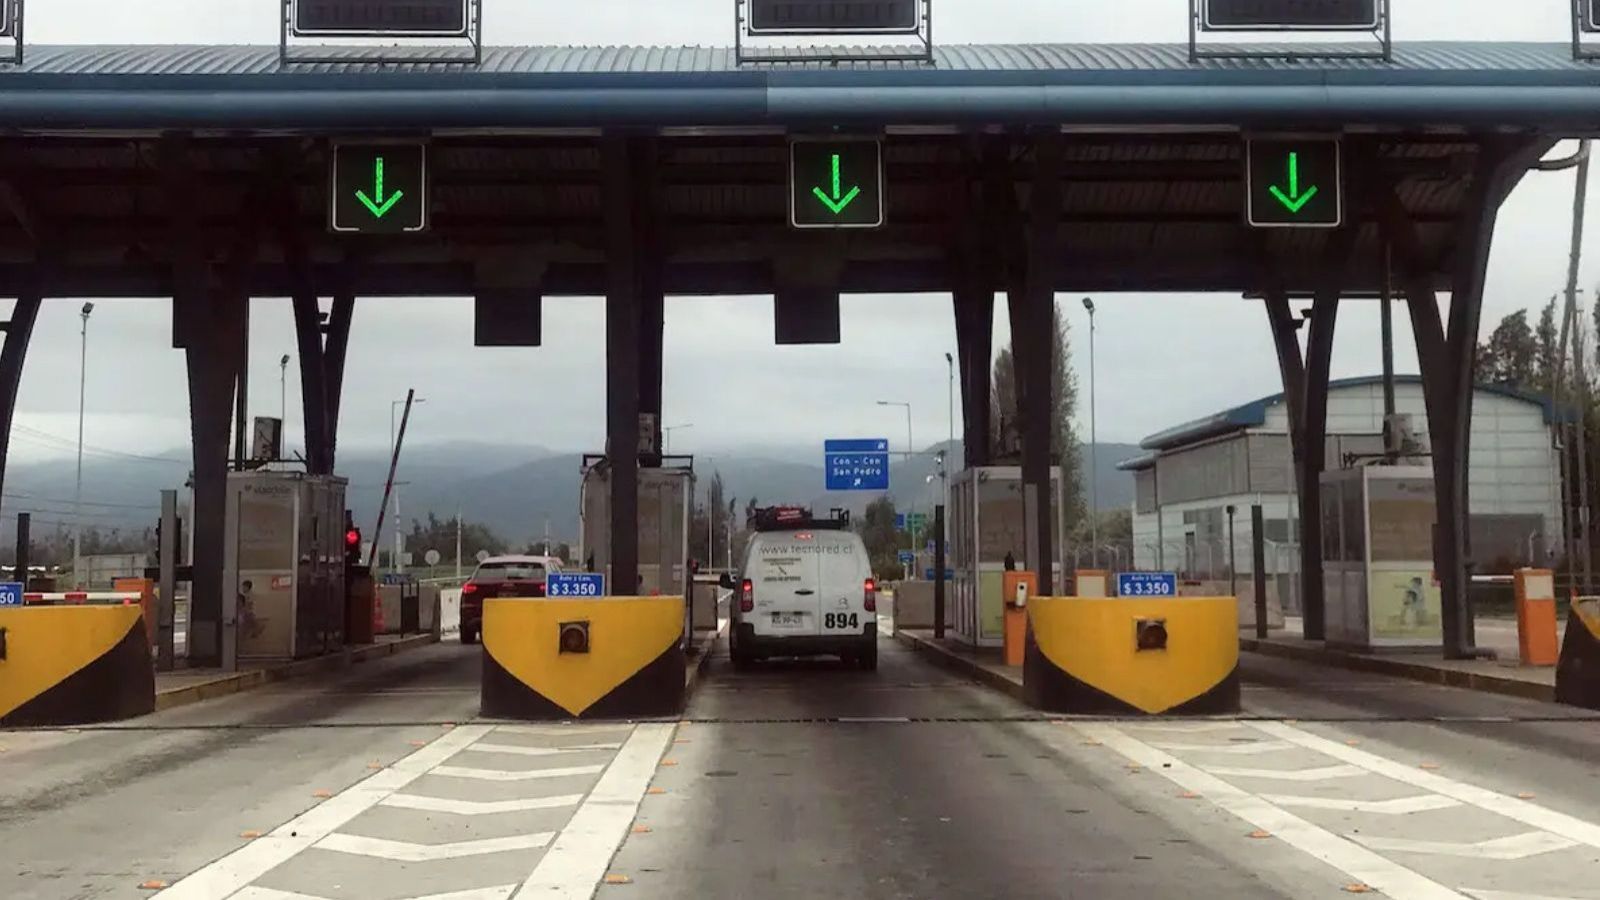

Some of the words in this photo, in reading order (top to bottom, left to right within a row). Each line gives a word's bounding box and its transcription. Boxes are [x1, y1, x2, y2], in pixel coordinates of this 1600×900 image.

[833, 457, 850, 465] Con
[863, 456, 880, 465] Con
[833, 467, 850, 476] San
[854, 467, 880, 476] Pedro
[551, 583, 559, 595] $
[561, 583, 596, 595] 3.350
[1124, 582, 1131, 594] $
[1135, 582, 1169, 594] 3.350
[825, 612, 858, 629] 894
